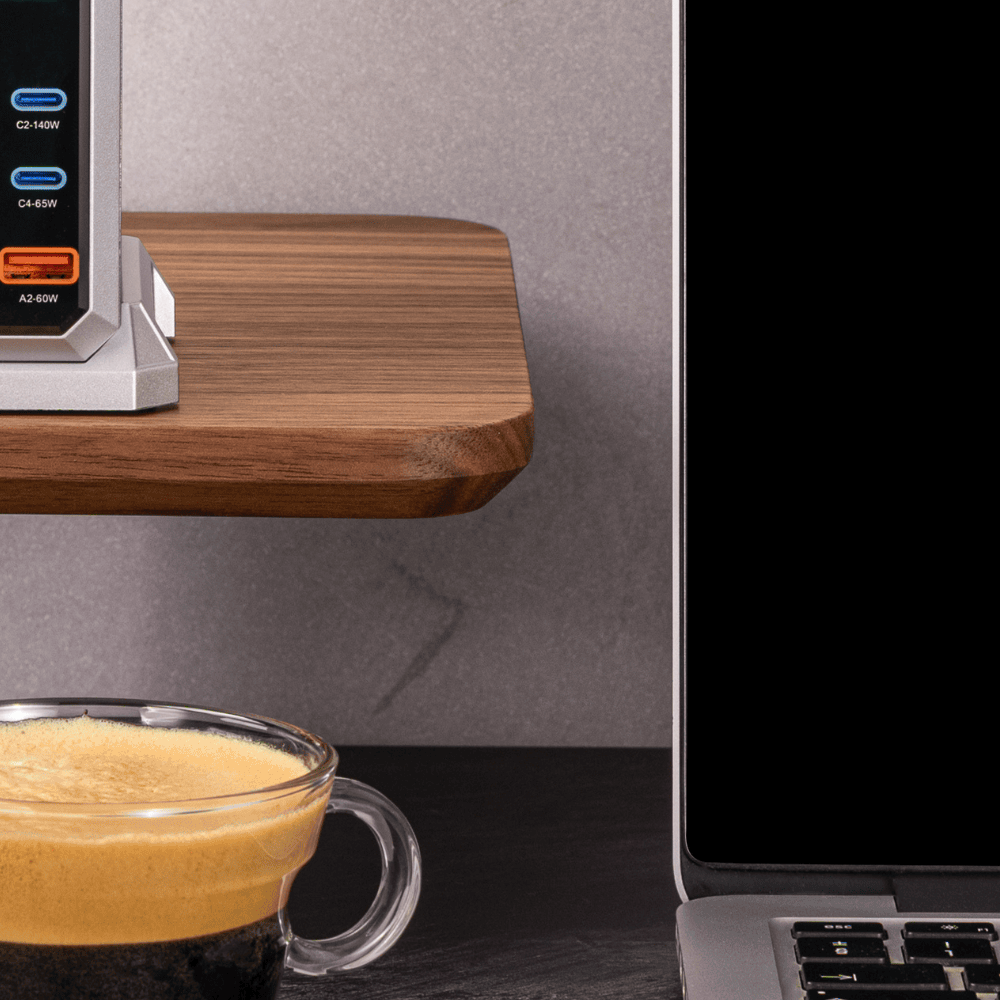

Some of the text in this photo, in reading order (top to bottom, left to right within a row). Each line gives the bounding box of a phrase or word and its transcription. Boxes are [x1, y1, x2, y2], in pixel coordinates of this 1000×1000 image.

[16, 120, 60, 130] C2-140W
[17, 198, 58, 209] C4-65W
[18, 293, 59, 304] A2-60W
